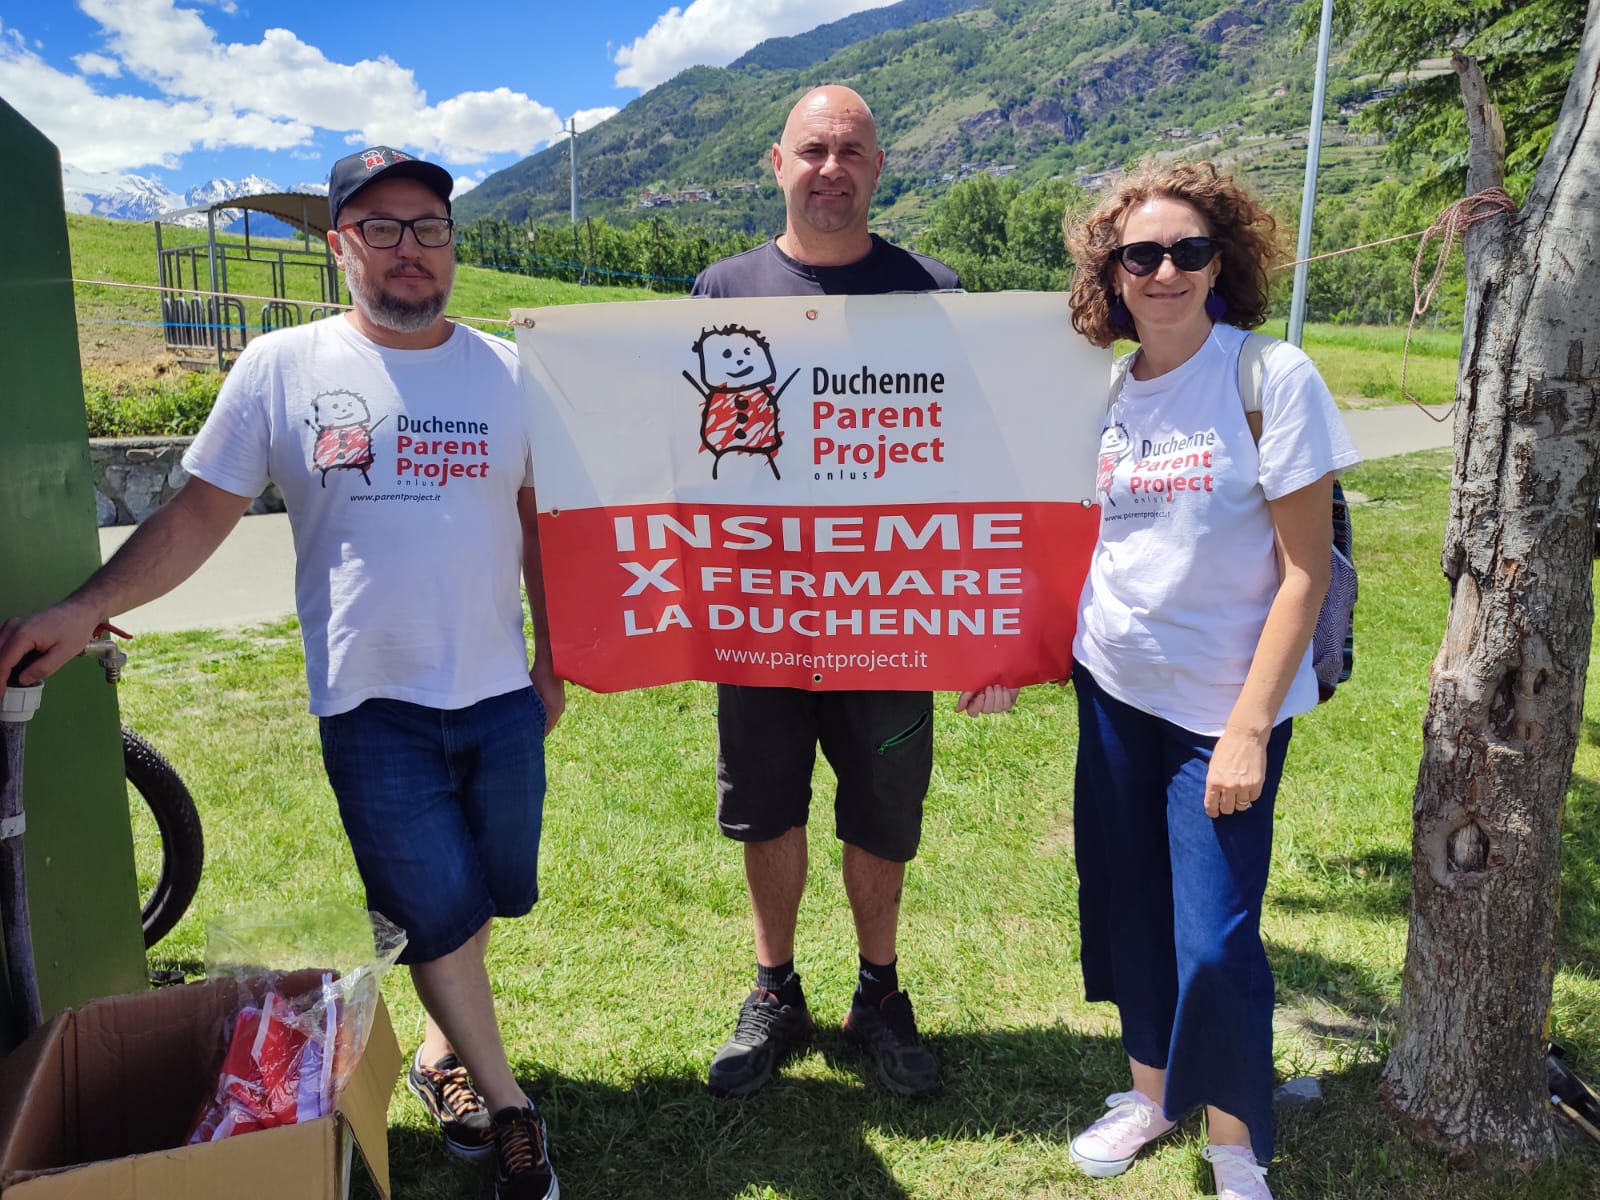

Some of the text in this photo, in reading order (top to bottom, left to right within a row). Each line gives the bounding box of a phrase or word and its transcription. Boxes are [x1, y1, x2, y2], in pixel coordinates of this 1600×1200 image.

[812, 365, 945, 395] Duchenne
[397, 414, 489, 435] Duchenne
[813, 401, 942, 429] Parent
[396, 435, 489, 456] Parent
[813, 434, 945, 479] Project
[396, 458, 490, 487] Project
[814, 469, 868, 480] onlus
[1133, 450, 1212, 473] Parent
[397, 478, 434, 487] onlus
[1130, 473, 1213, 503] Project
[350, 492, 441, 503] www.parentproject.it
[613, 512, 1024, 552] INSIEME
[618, 558, 1024, 598] X FERMARE
[623, 604, 1021, 637] LA DUCHENNE
[714, 646, 928, 673] www.parentproject.it
